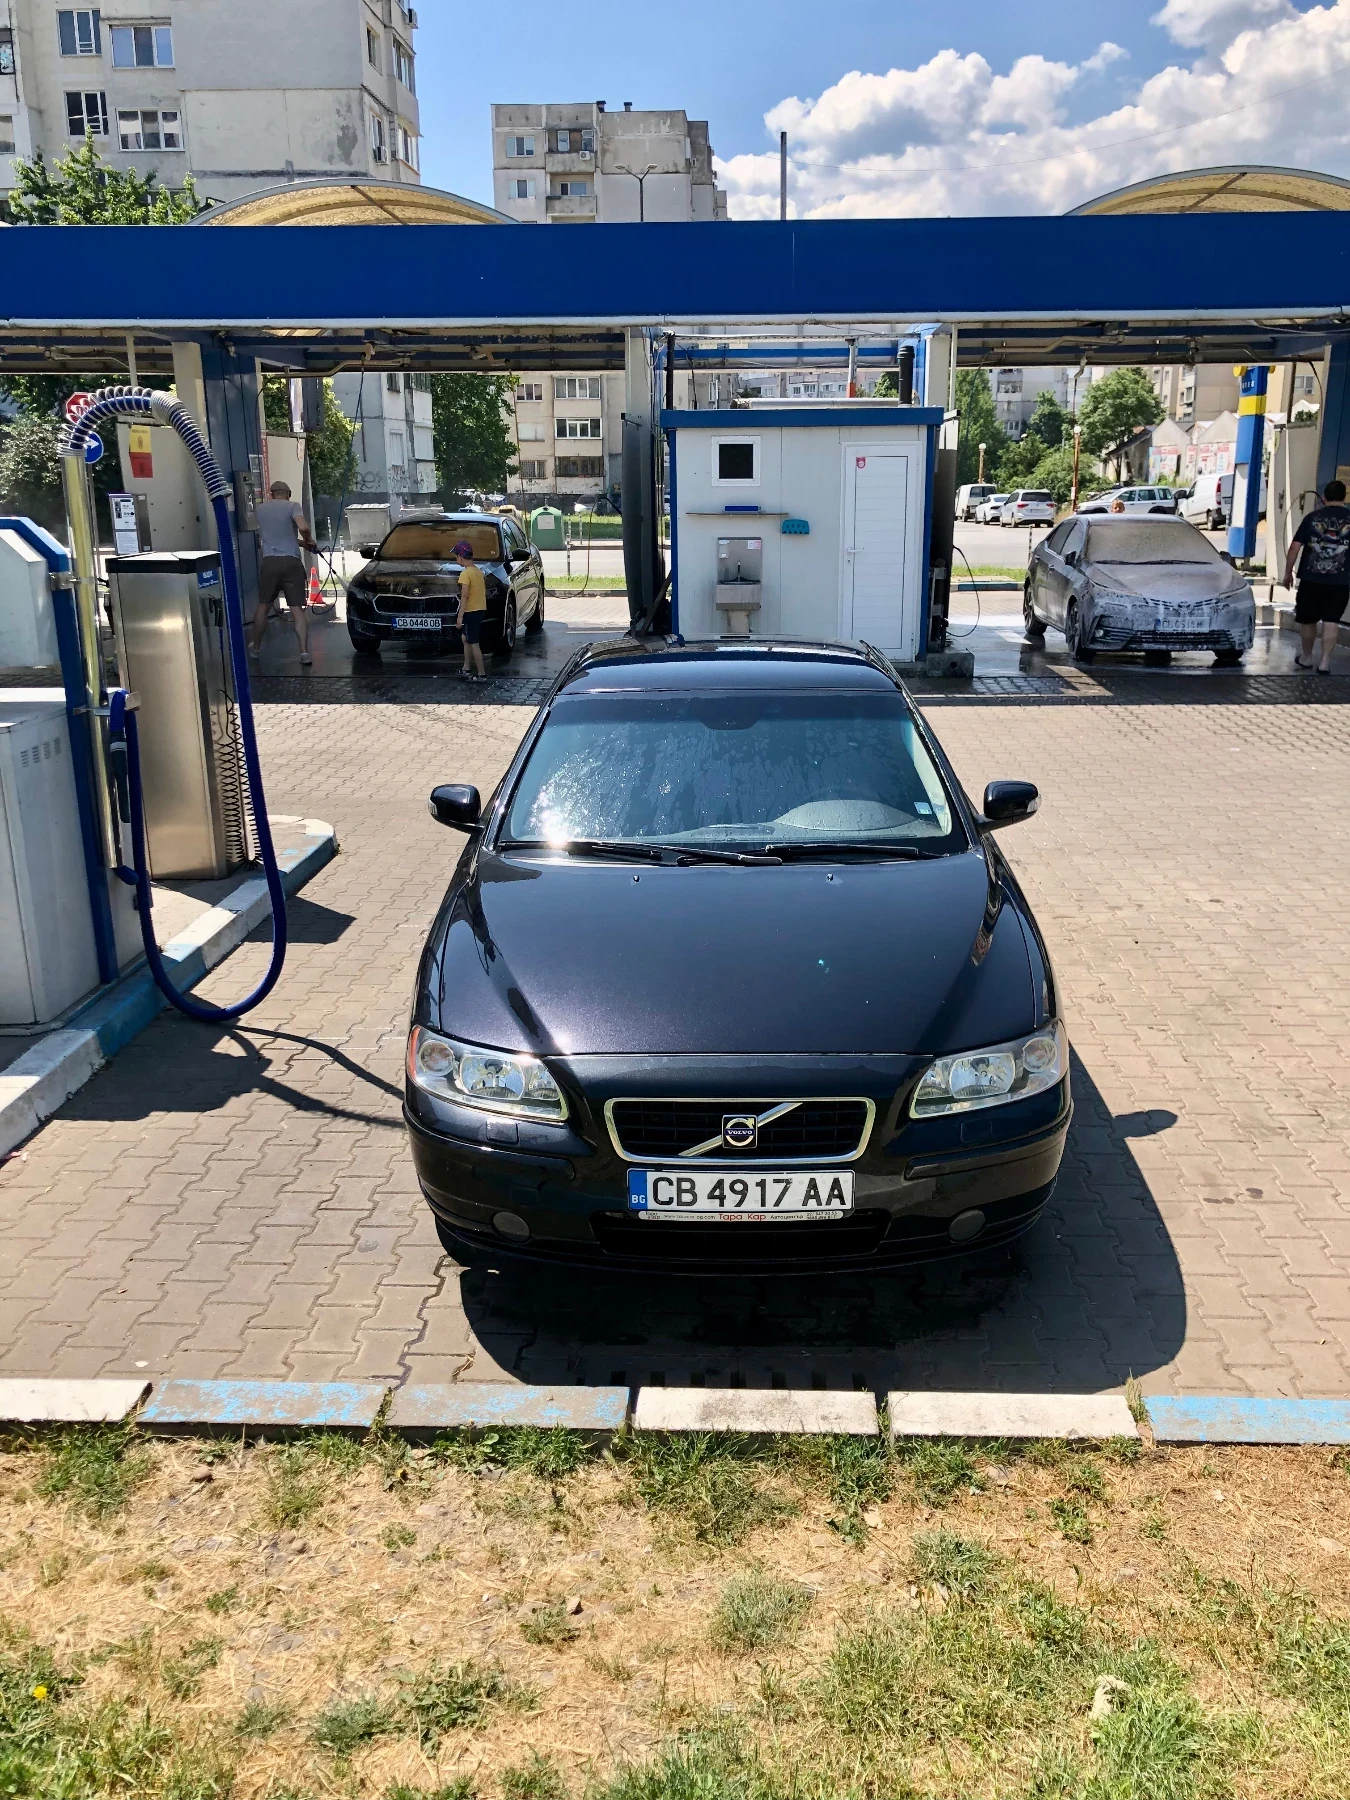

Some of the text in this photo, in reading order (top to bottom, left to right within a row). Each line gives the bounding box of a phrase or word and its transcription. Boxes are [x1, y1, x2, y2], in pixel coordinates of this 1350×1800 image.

[409, 619, 429, 627] 0448
[652, 1177, 847, 1208] CB 4917 AA
[631, 1194, 646, 1204] BG
